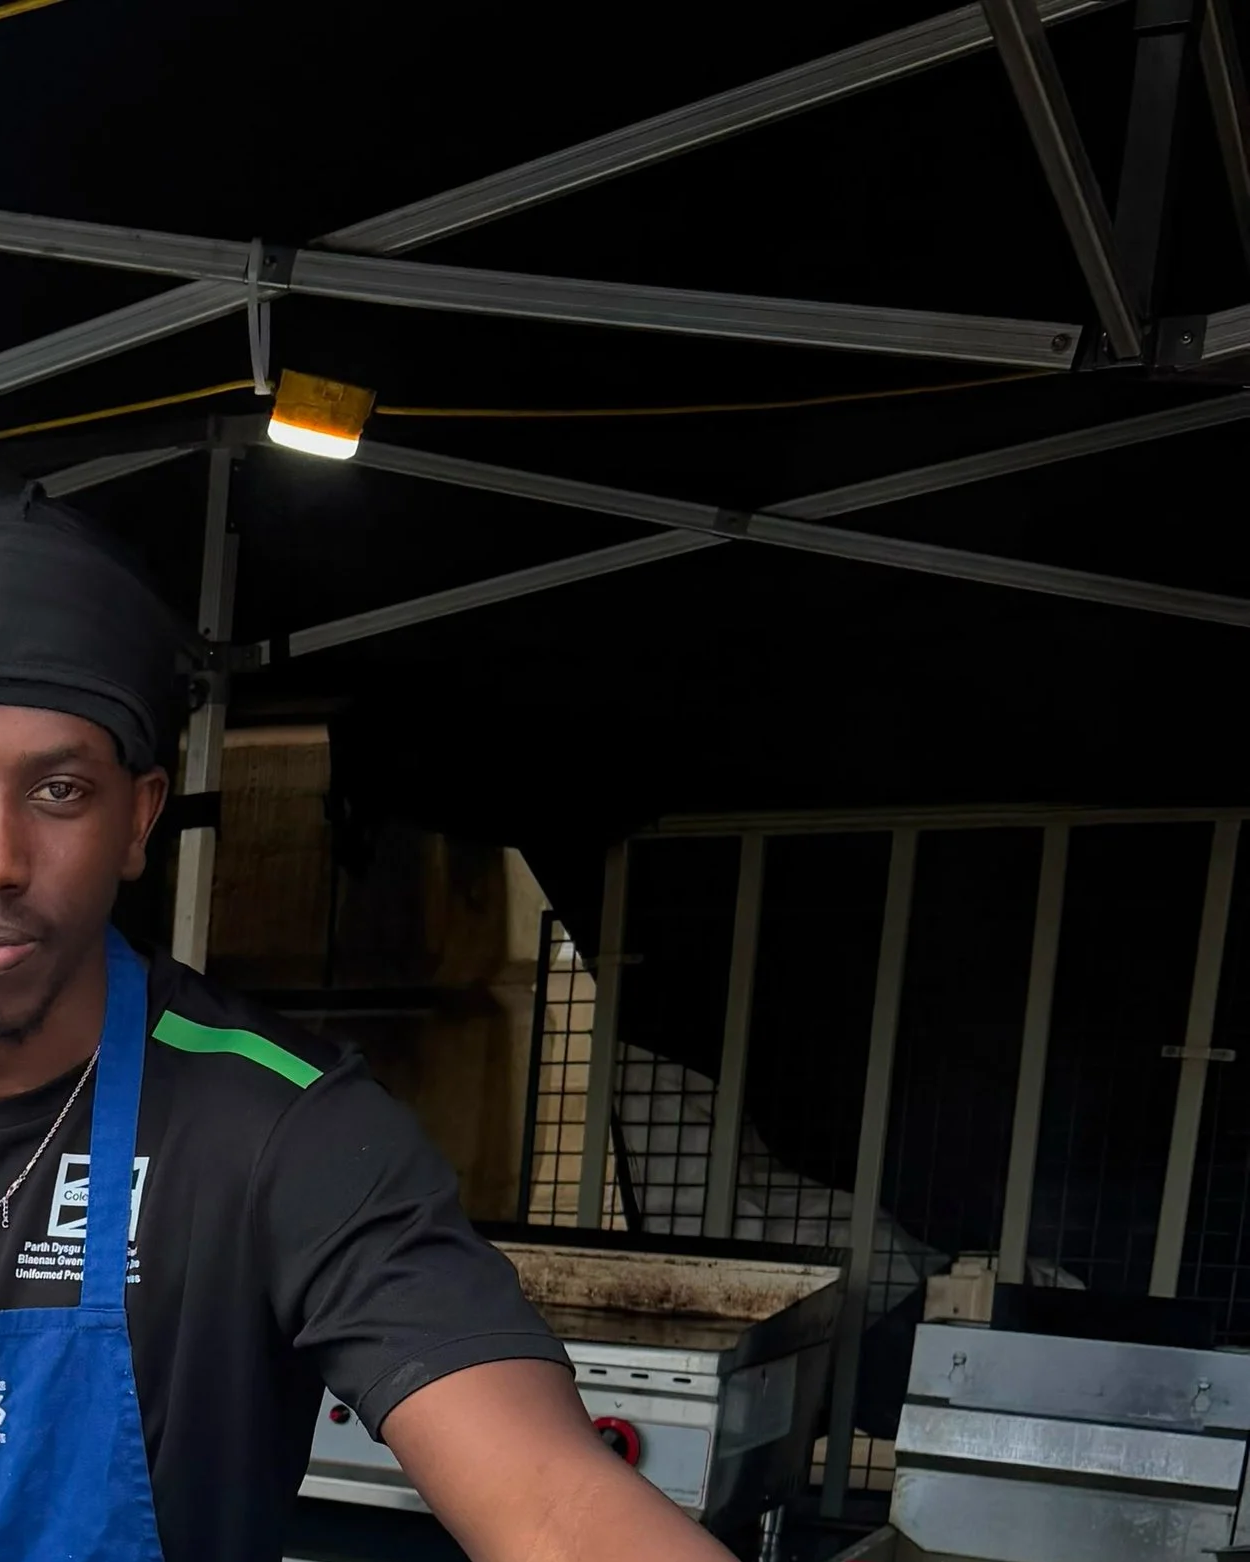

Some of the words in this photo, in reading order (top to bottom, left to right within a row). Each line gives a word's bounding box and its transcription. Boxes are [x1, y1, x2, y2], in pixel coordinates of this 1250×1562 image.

[24, 1241, 50, 1252] Parth
[51, 1242, 81, 1255] Dysgu
[15, 1268, 62, 1280] Uniformed
